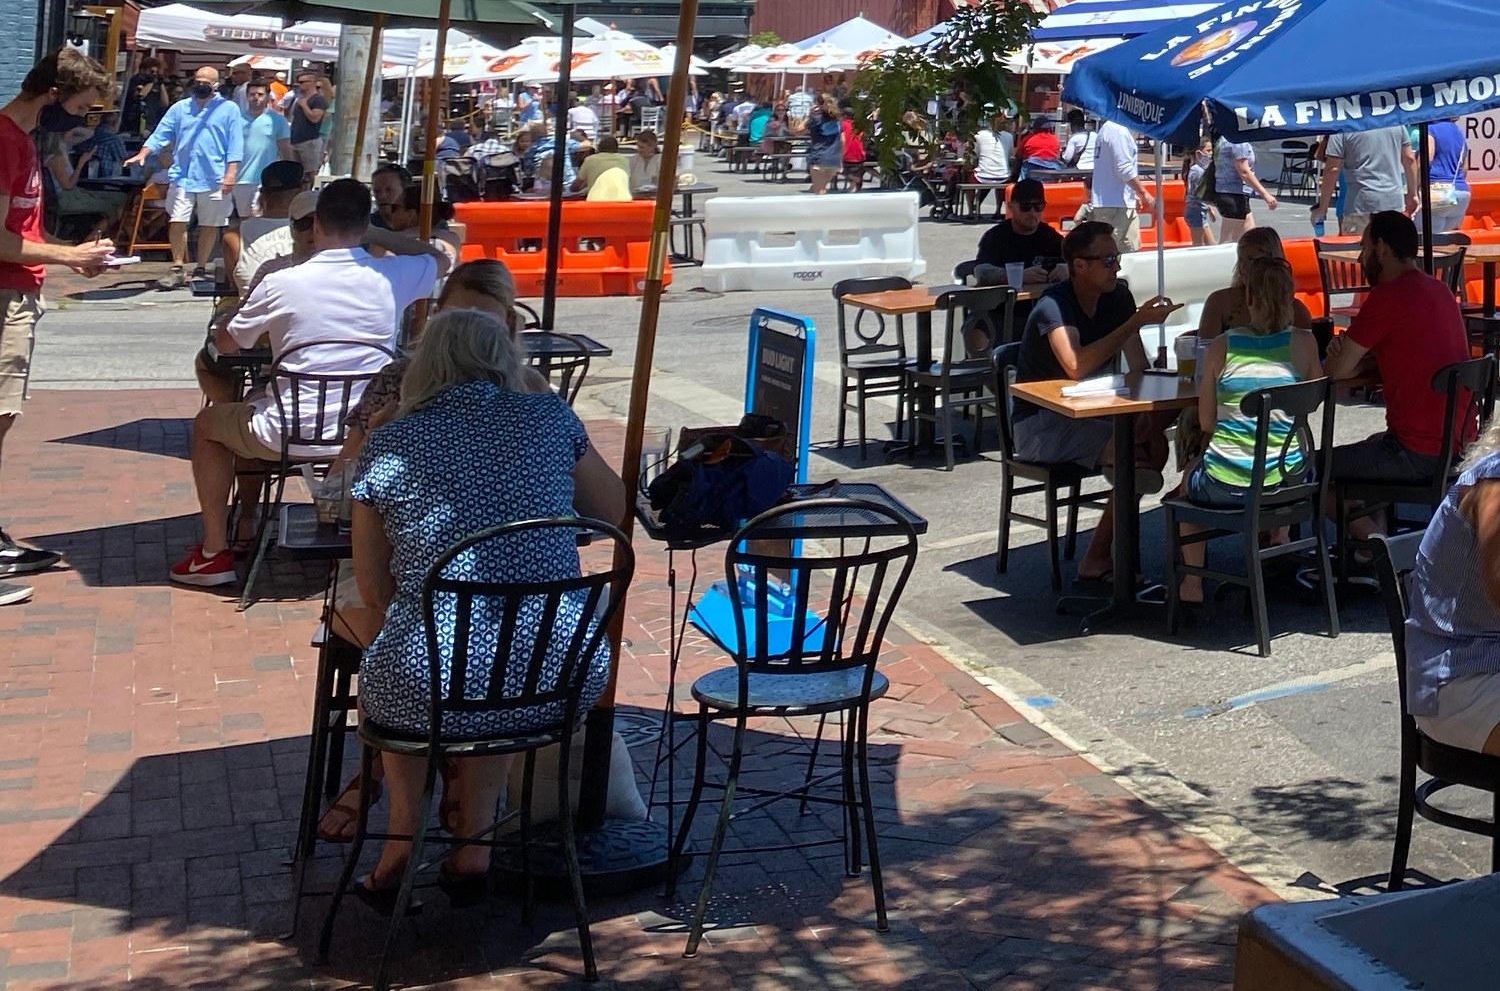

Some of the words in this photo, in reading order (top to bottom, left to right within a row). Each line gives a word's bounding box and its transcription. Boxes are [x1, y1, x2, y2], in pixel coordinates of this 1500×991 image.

[221, 28, 286, 43] FEDERAL
[1140, 35, 1192, 61] LA
[1196, 1, 1263, 34] FIN
[1234, 105, 1287, 131] LA
[1296, 94, 1363, 125] FIN
[1370, 86, 1423, 116] DU
